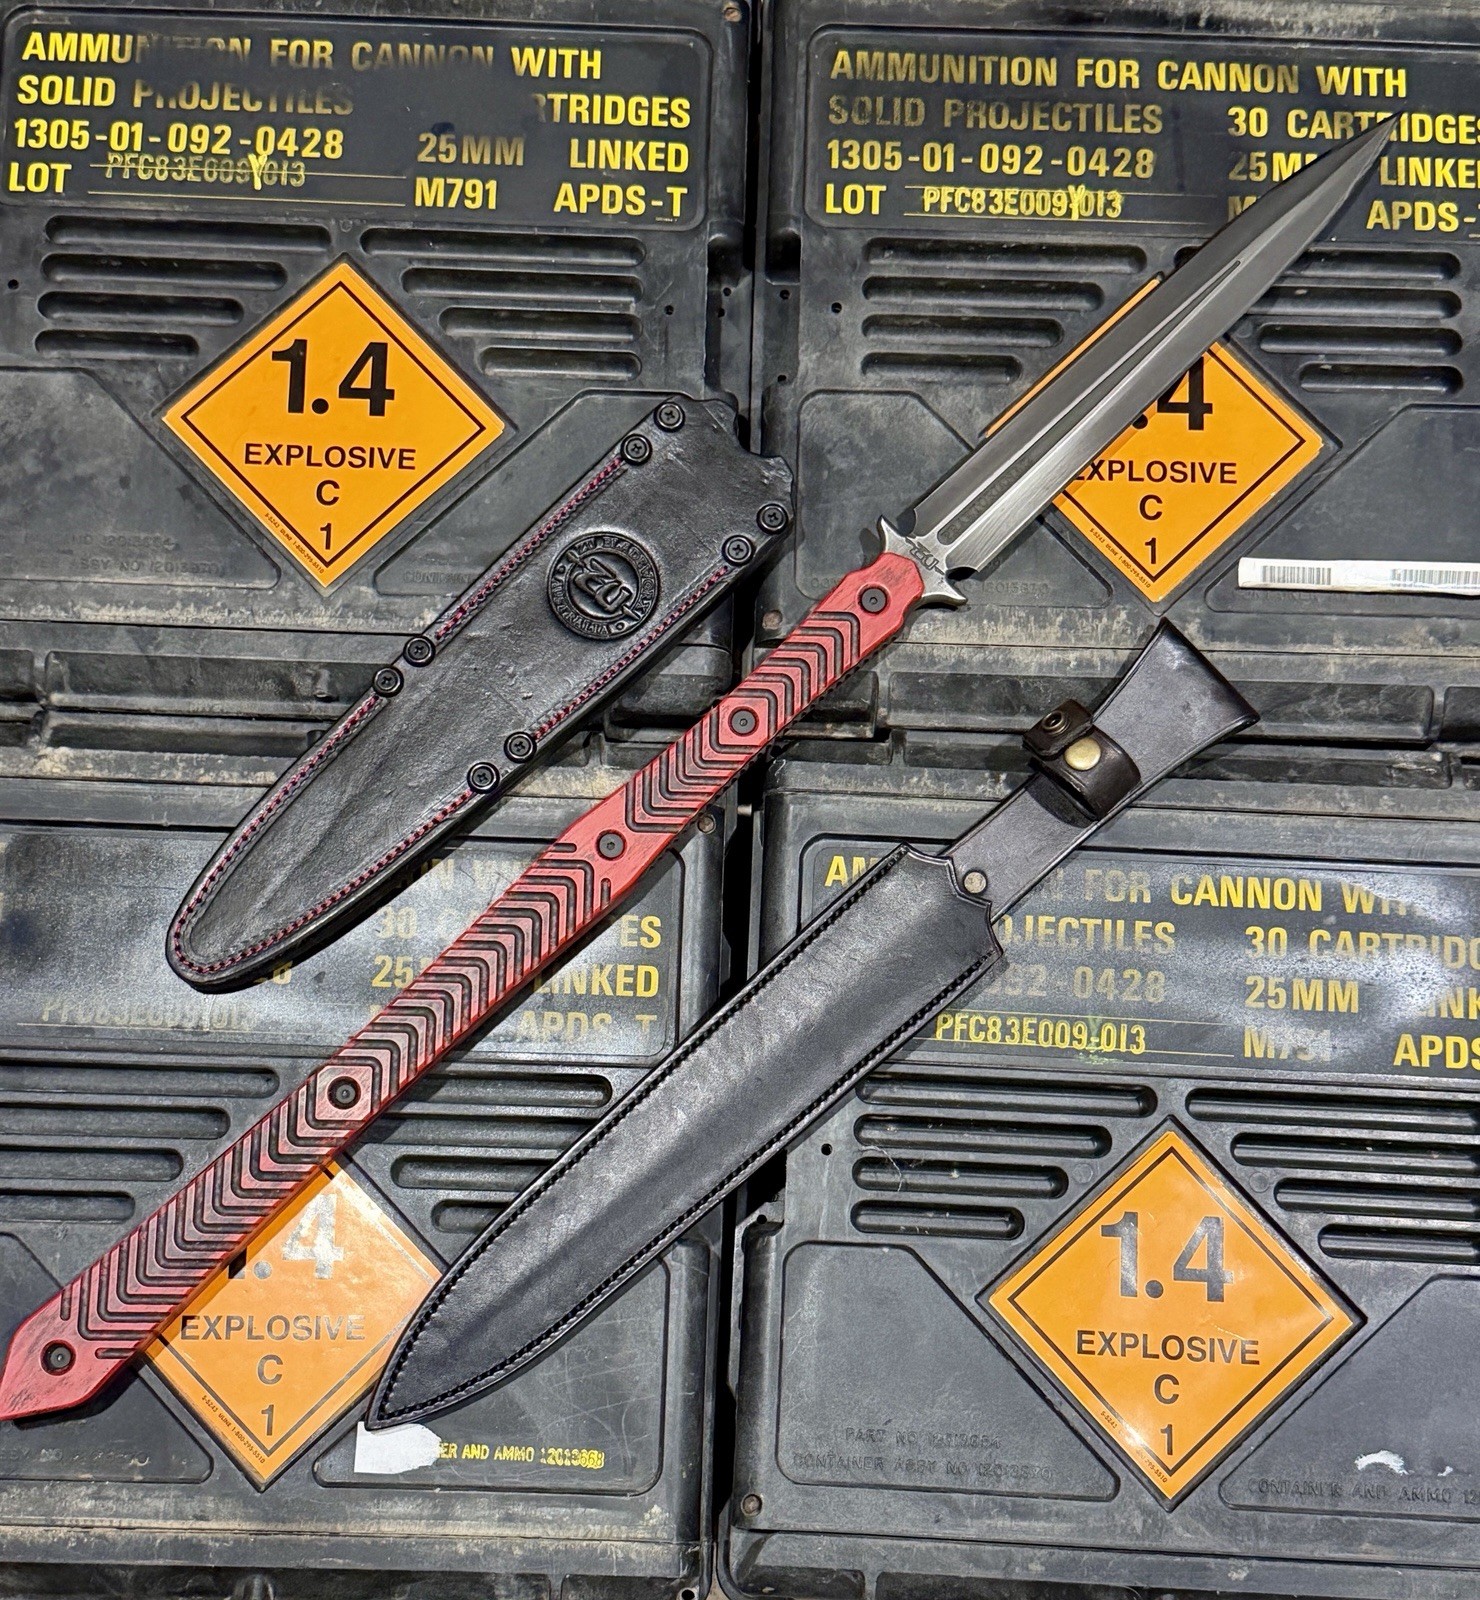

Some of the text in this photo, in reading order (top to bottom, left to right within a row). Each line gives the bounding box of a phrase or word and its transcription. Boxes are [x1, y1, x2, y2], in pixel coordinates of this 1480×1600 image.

[270, 38, 335, 70] FOR
[511, 46, 601, 80] WITH
[830, 50, 1407, 98] AMMUNITION FOR CANNON WITH
[17, 75, 116, 107] SOLID
[828, 94, 1480, 145] SOLID PROJECTILES 30 CARTIDGE
[417, 132, 526, 166] 25MM
[570, 138, 689, 173] LINKED
[1227, 151, 1318, 183] 25M
[1380, 156, 1480, 189] LINKE
[8, 162, 72, 193] LOT
[415, 177, 498, 210] M791
[554, 182, 688, 217] APDS-T
[825, 183, 887, 215] LOT
[1366, 200, 1480, 232] APDS-
[271, 338, 395, 417] 1.4
[244, 443, 416, 470] EXPLOSIVE
[316, 479, 340, 506] C
[1139, 494, 1163, 521] C
[320, 522, 332, 550] 1
[1144, 537, 1157, 564] 1
[1084, 868, 1151, 904] FOR
[1171, 874, 1322, 912] CANNON
[1245, 925, 1287, 958] 30
[1245, 975, 1358, 1013] 25MM
[1101, 1211, 1233, 1302] 1.4
[180, 1314, 366, 1341] EXPLOSIVE
[1076, 1330, 1259, 1365] EXPLOSIVE
[257, 1354, 283, 1385] C
[1154, 1374, 1179, 1404] C
[261, 1404, 275, 1436] 1
[461, 1444, 489, 1460] AND
[493, 1445, 534, 1462] AMMO
[1160, 1424, 1173, 1455] 1
